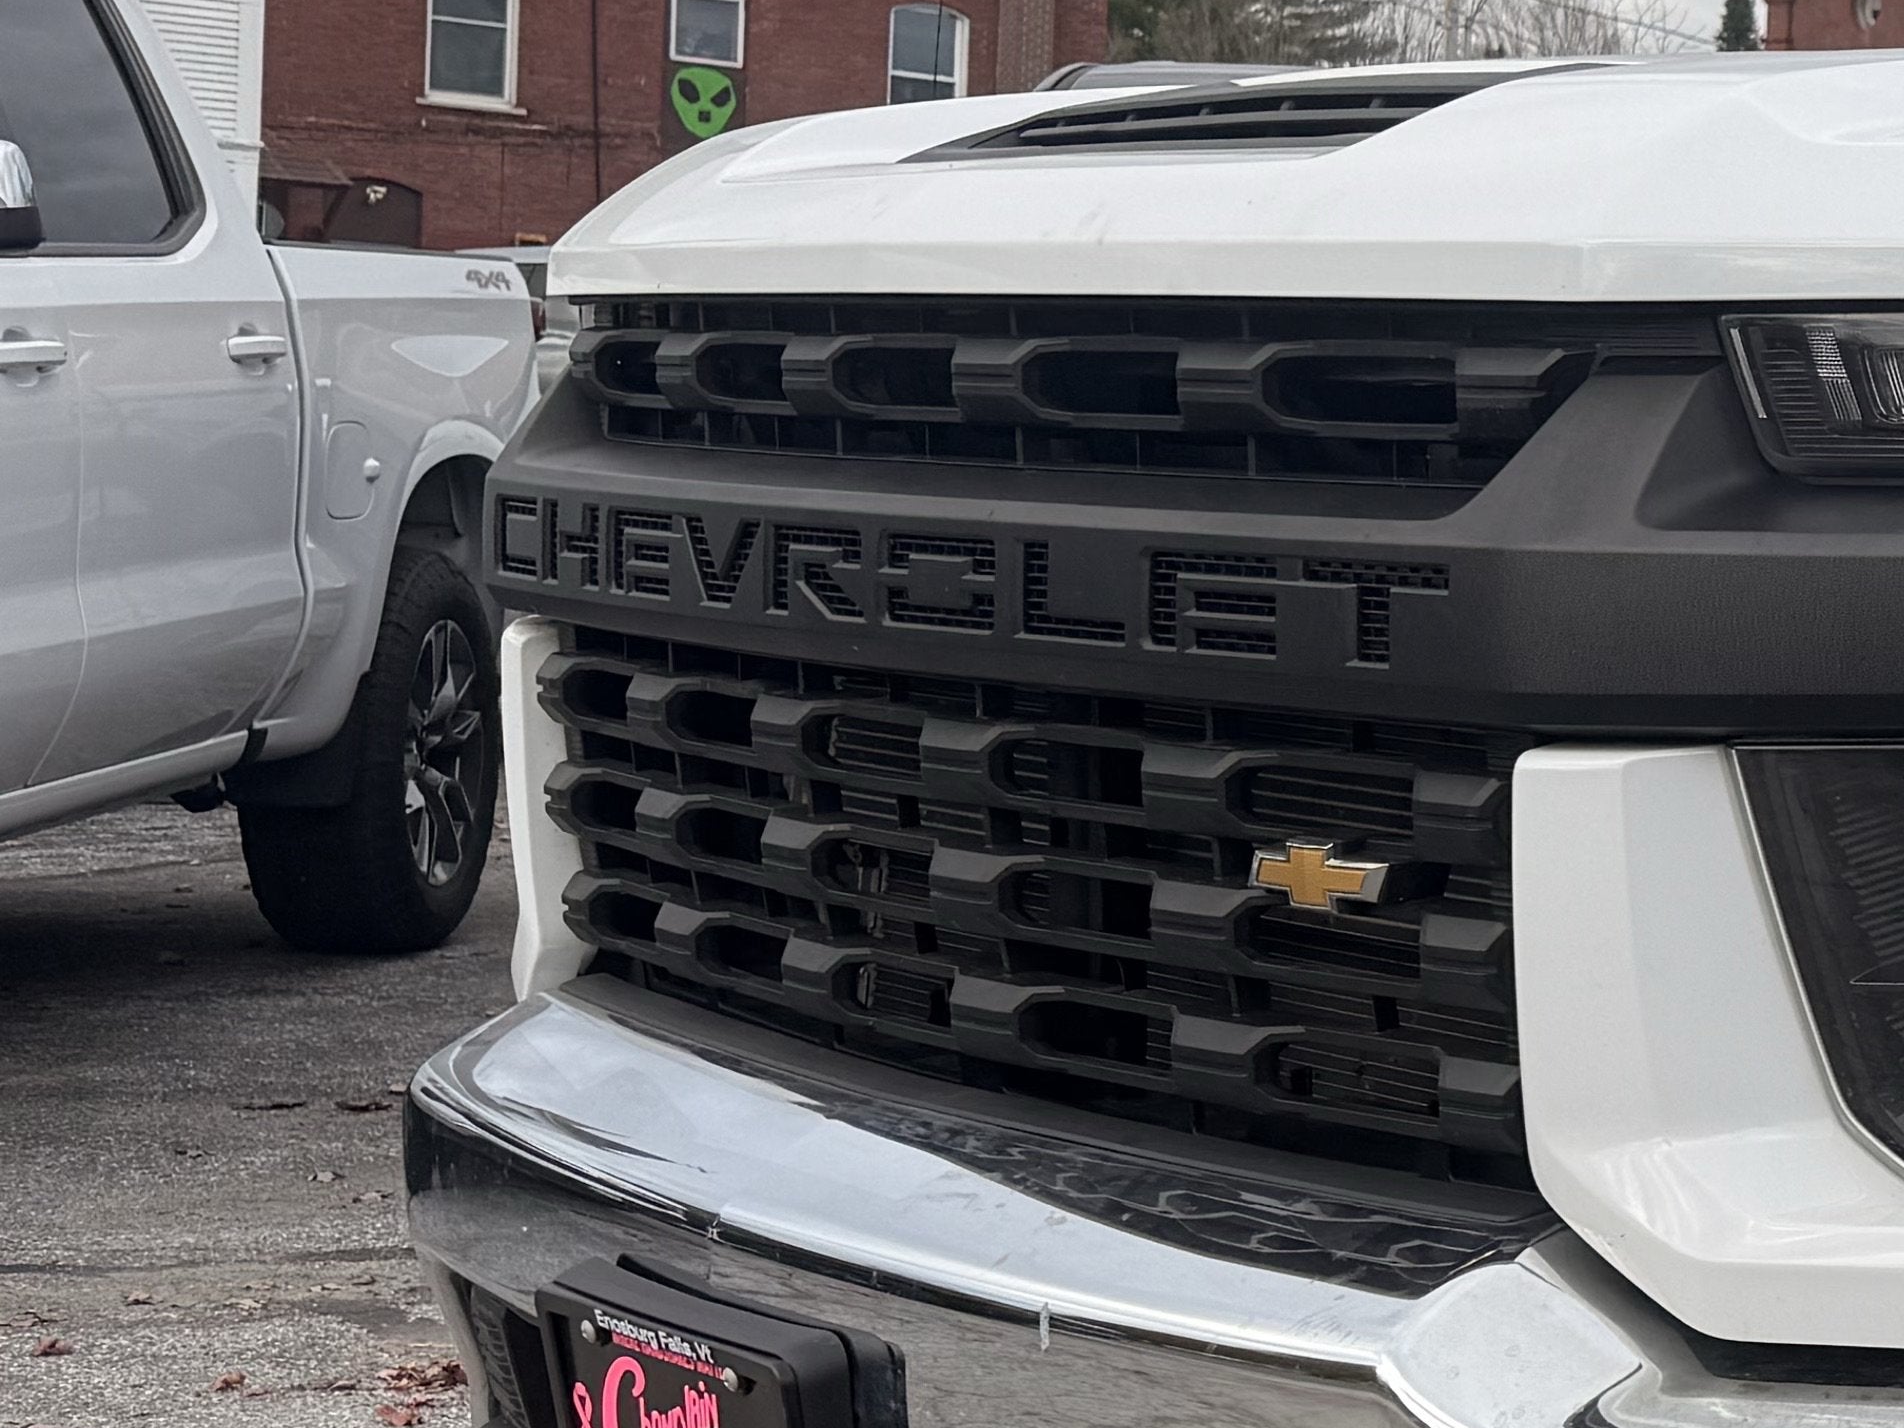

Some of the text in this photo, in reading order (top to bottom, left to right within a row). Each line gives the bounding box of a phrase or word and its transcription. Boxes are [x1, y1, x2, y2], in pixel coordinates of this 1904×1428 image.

[494, 494, 1452, 671] CHEVROLET
[593, 1309, 658, 1349] Enosburg
[657, 1330, 698, 1361] Falls,
[694, 1341, 715, 1364] Vt
